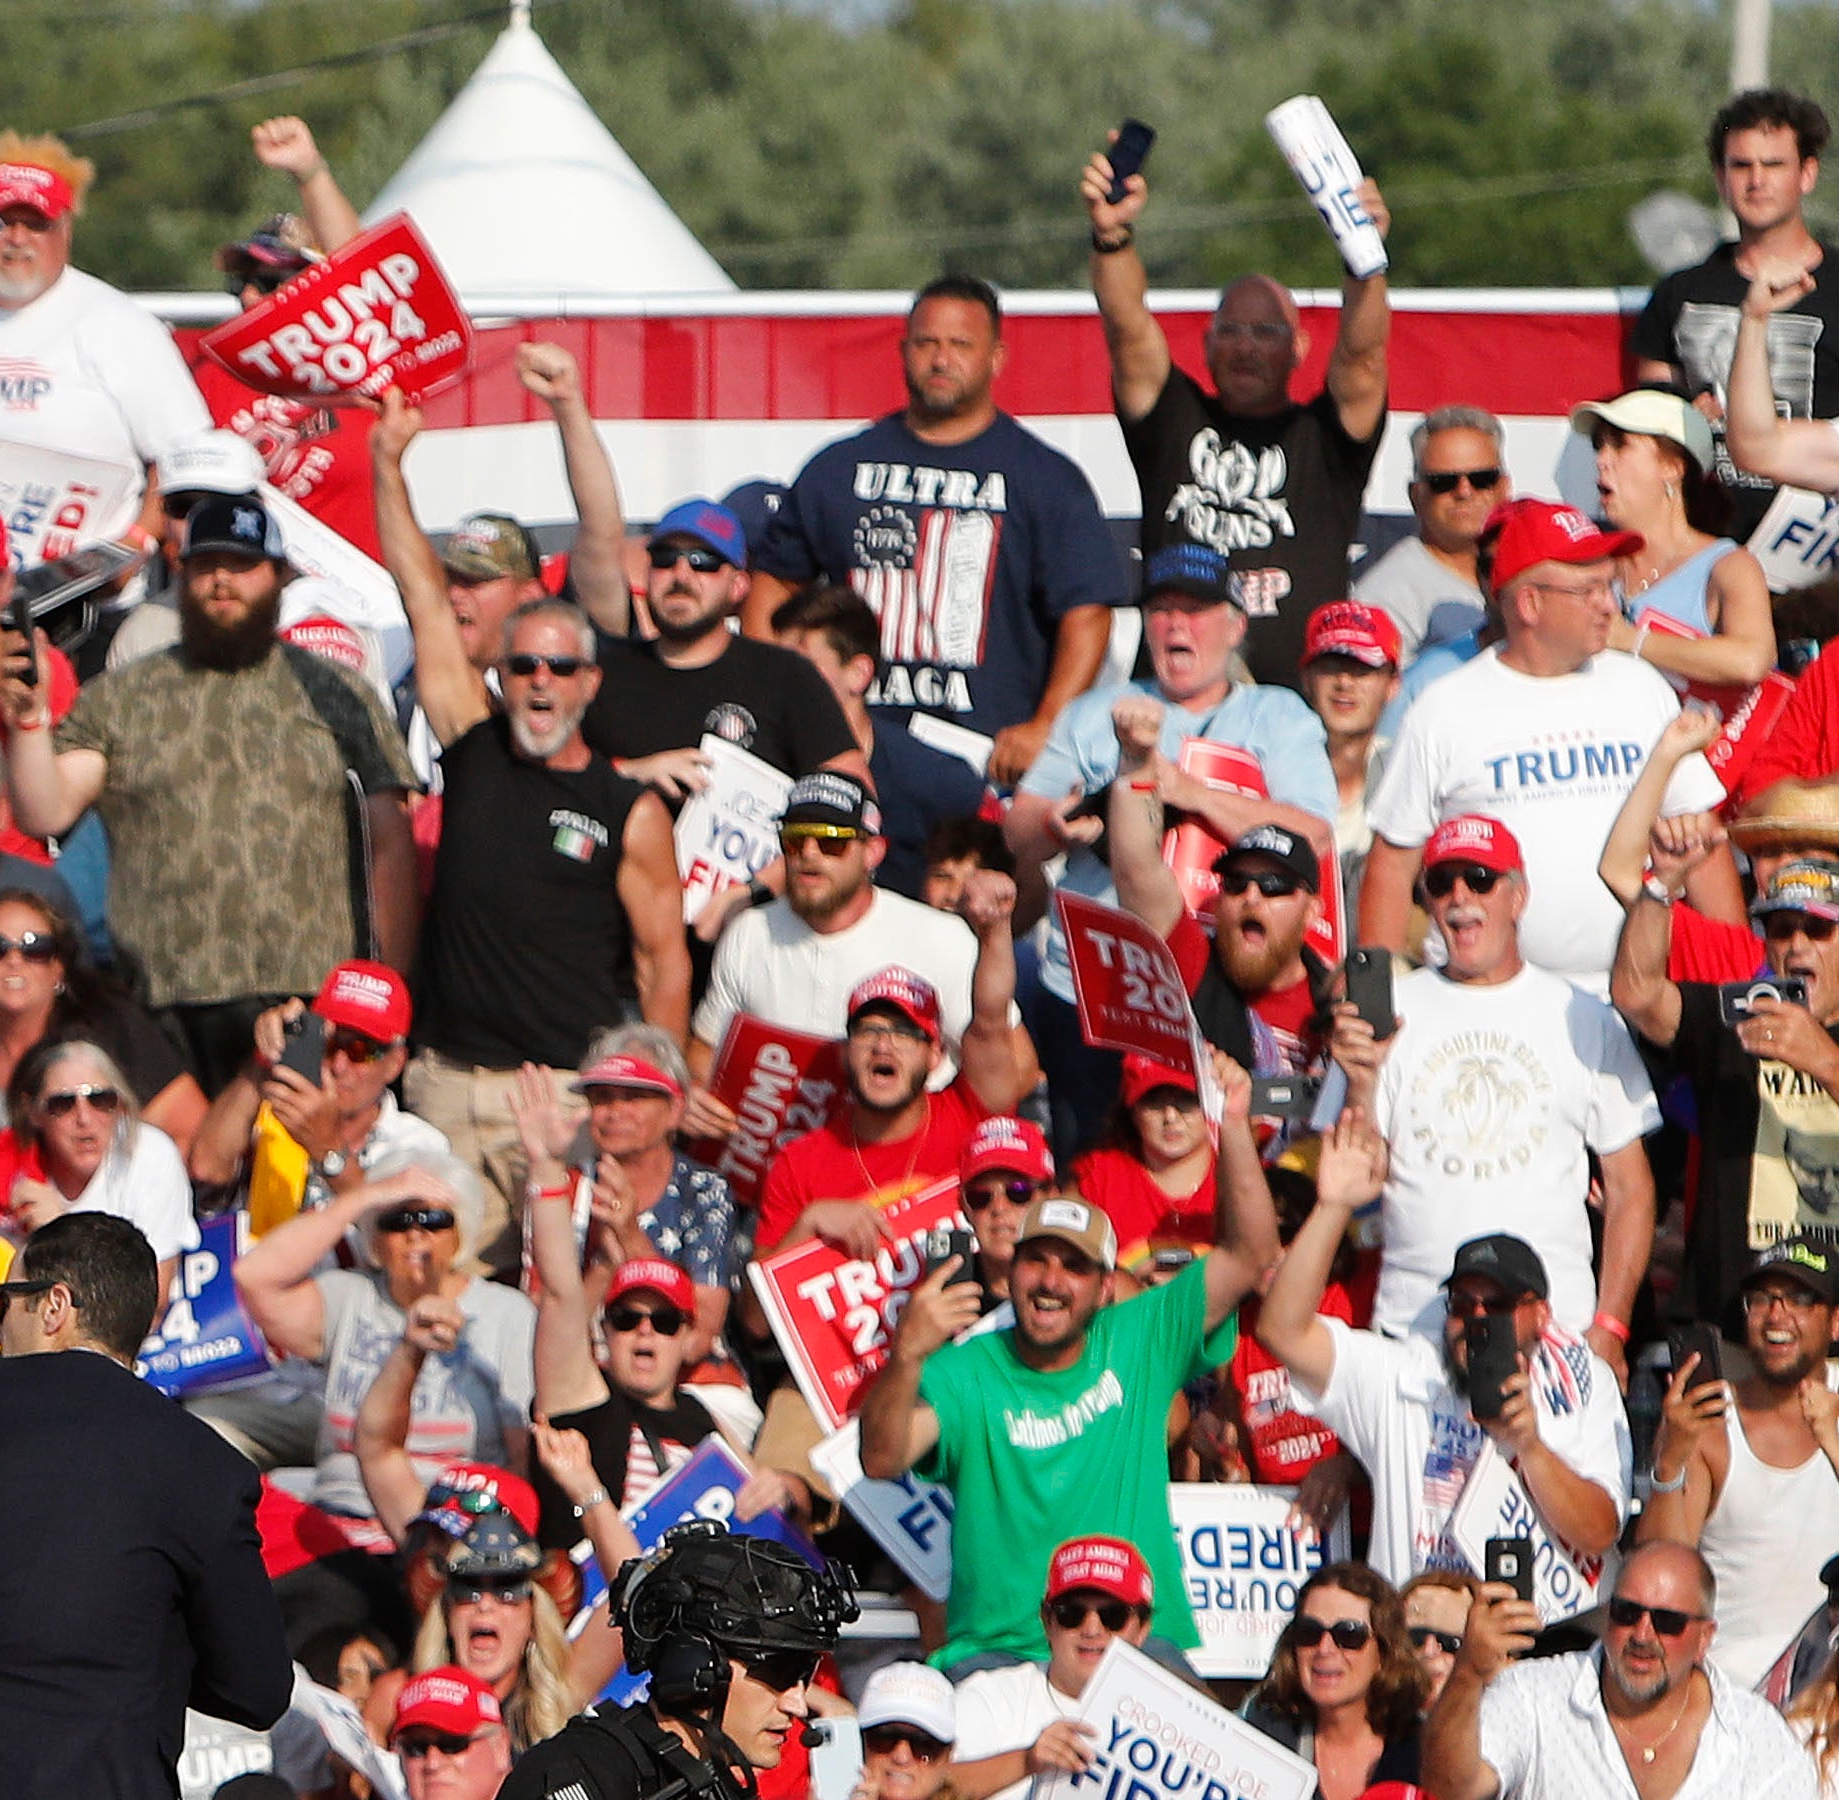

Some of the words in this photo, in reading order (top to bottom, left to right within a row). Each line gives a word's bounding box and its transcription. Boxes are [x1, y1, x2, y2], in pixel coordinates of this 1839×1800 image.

[237, 251, 421, 382] TRUMP
[290, 298, 425, 393] 2024
[852, 462, 1009, 512] ULTRA
[1483, 742, 1646, 792] TRUMP
[721, 1041, 798, 1182] TRUMP
[1414, 1124, 1552, 1181] FLORIDA
[1278, 1434, 1323, 1465] 2024
[1189, 1576, 1299, 1612] OU'RE
[1116, 1692, 1222, 1773] CROOKED
[1222, 1745, 1269, 1800] JOE
